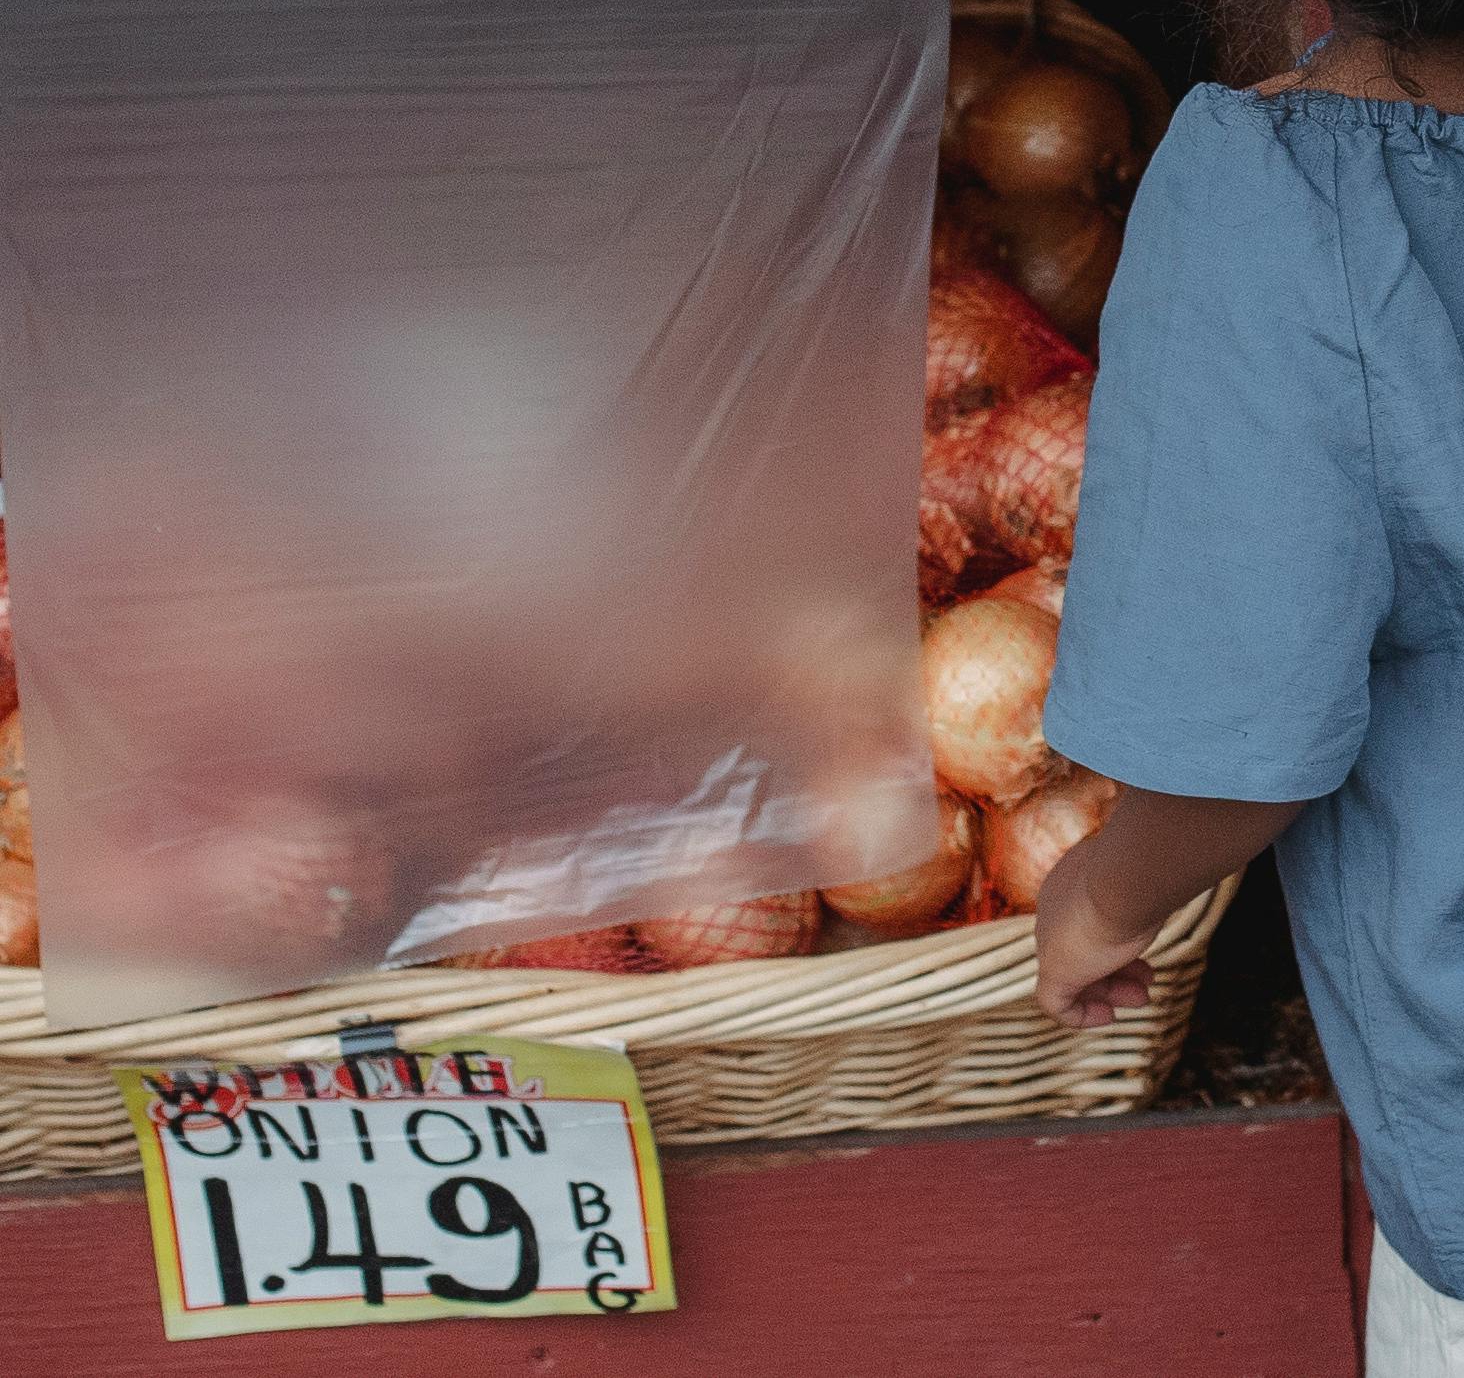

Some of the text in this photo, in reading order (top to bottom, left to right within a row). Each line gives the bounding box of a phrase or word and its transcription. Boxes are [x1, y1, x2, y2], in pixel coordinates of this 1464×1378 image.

[166, 1102, 549, 1167] ONION
[202, 1174, 543, 1307] 1.49
[566, 1180, 646, 1313] BAG
